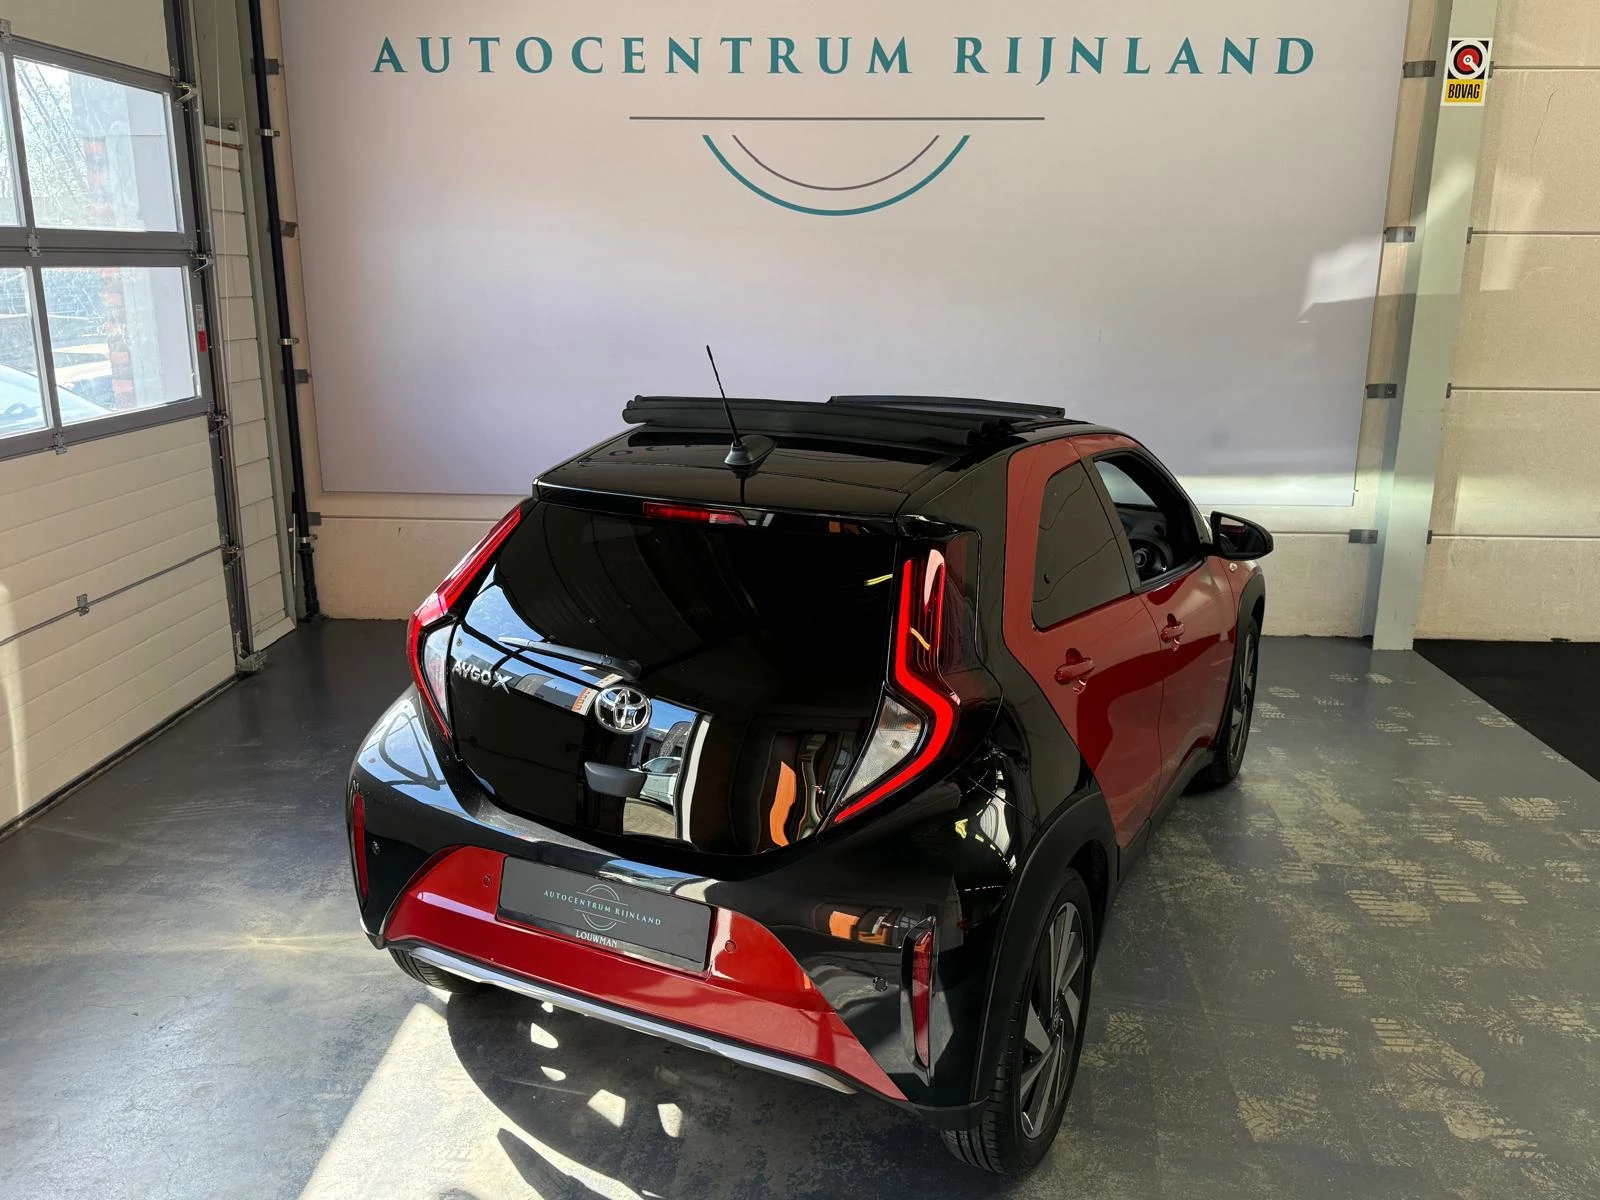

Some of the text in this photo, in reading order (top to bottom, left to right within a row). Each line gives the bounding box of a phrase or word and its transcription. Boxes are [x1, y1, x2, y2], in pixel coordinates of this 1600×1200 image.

[371, 36, 1315, 87] AUTOCENTRUM RIJNLAND
[1447, 83, 1481, 99] BOVAG
[452, 660, 491, 686] AYGO
[543, 889, 662, 926] AUTOCENTRUM RIJNLAND
[575, 929, 618, 949] LOUWMAN
